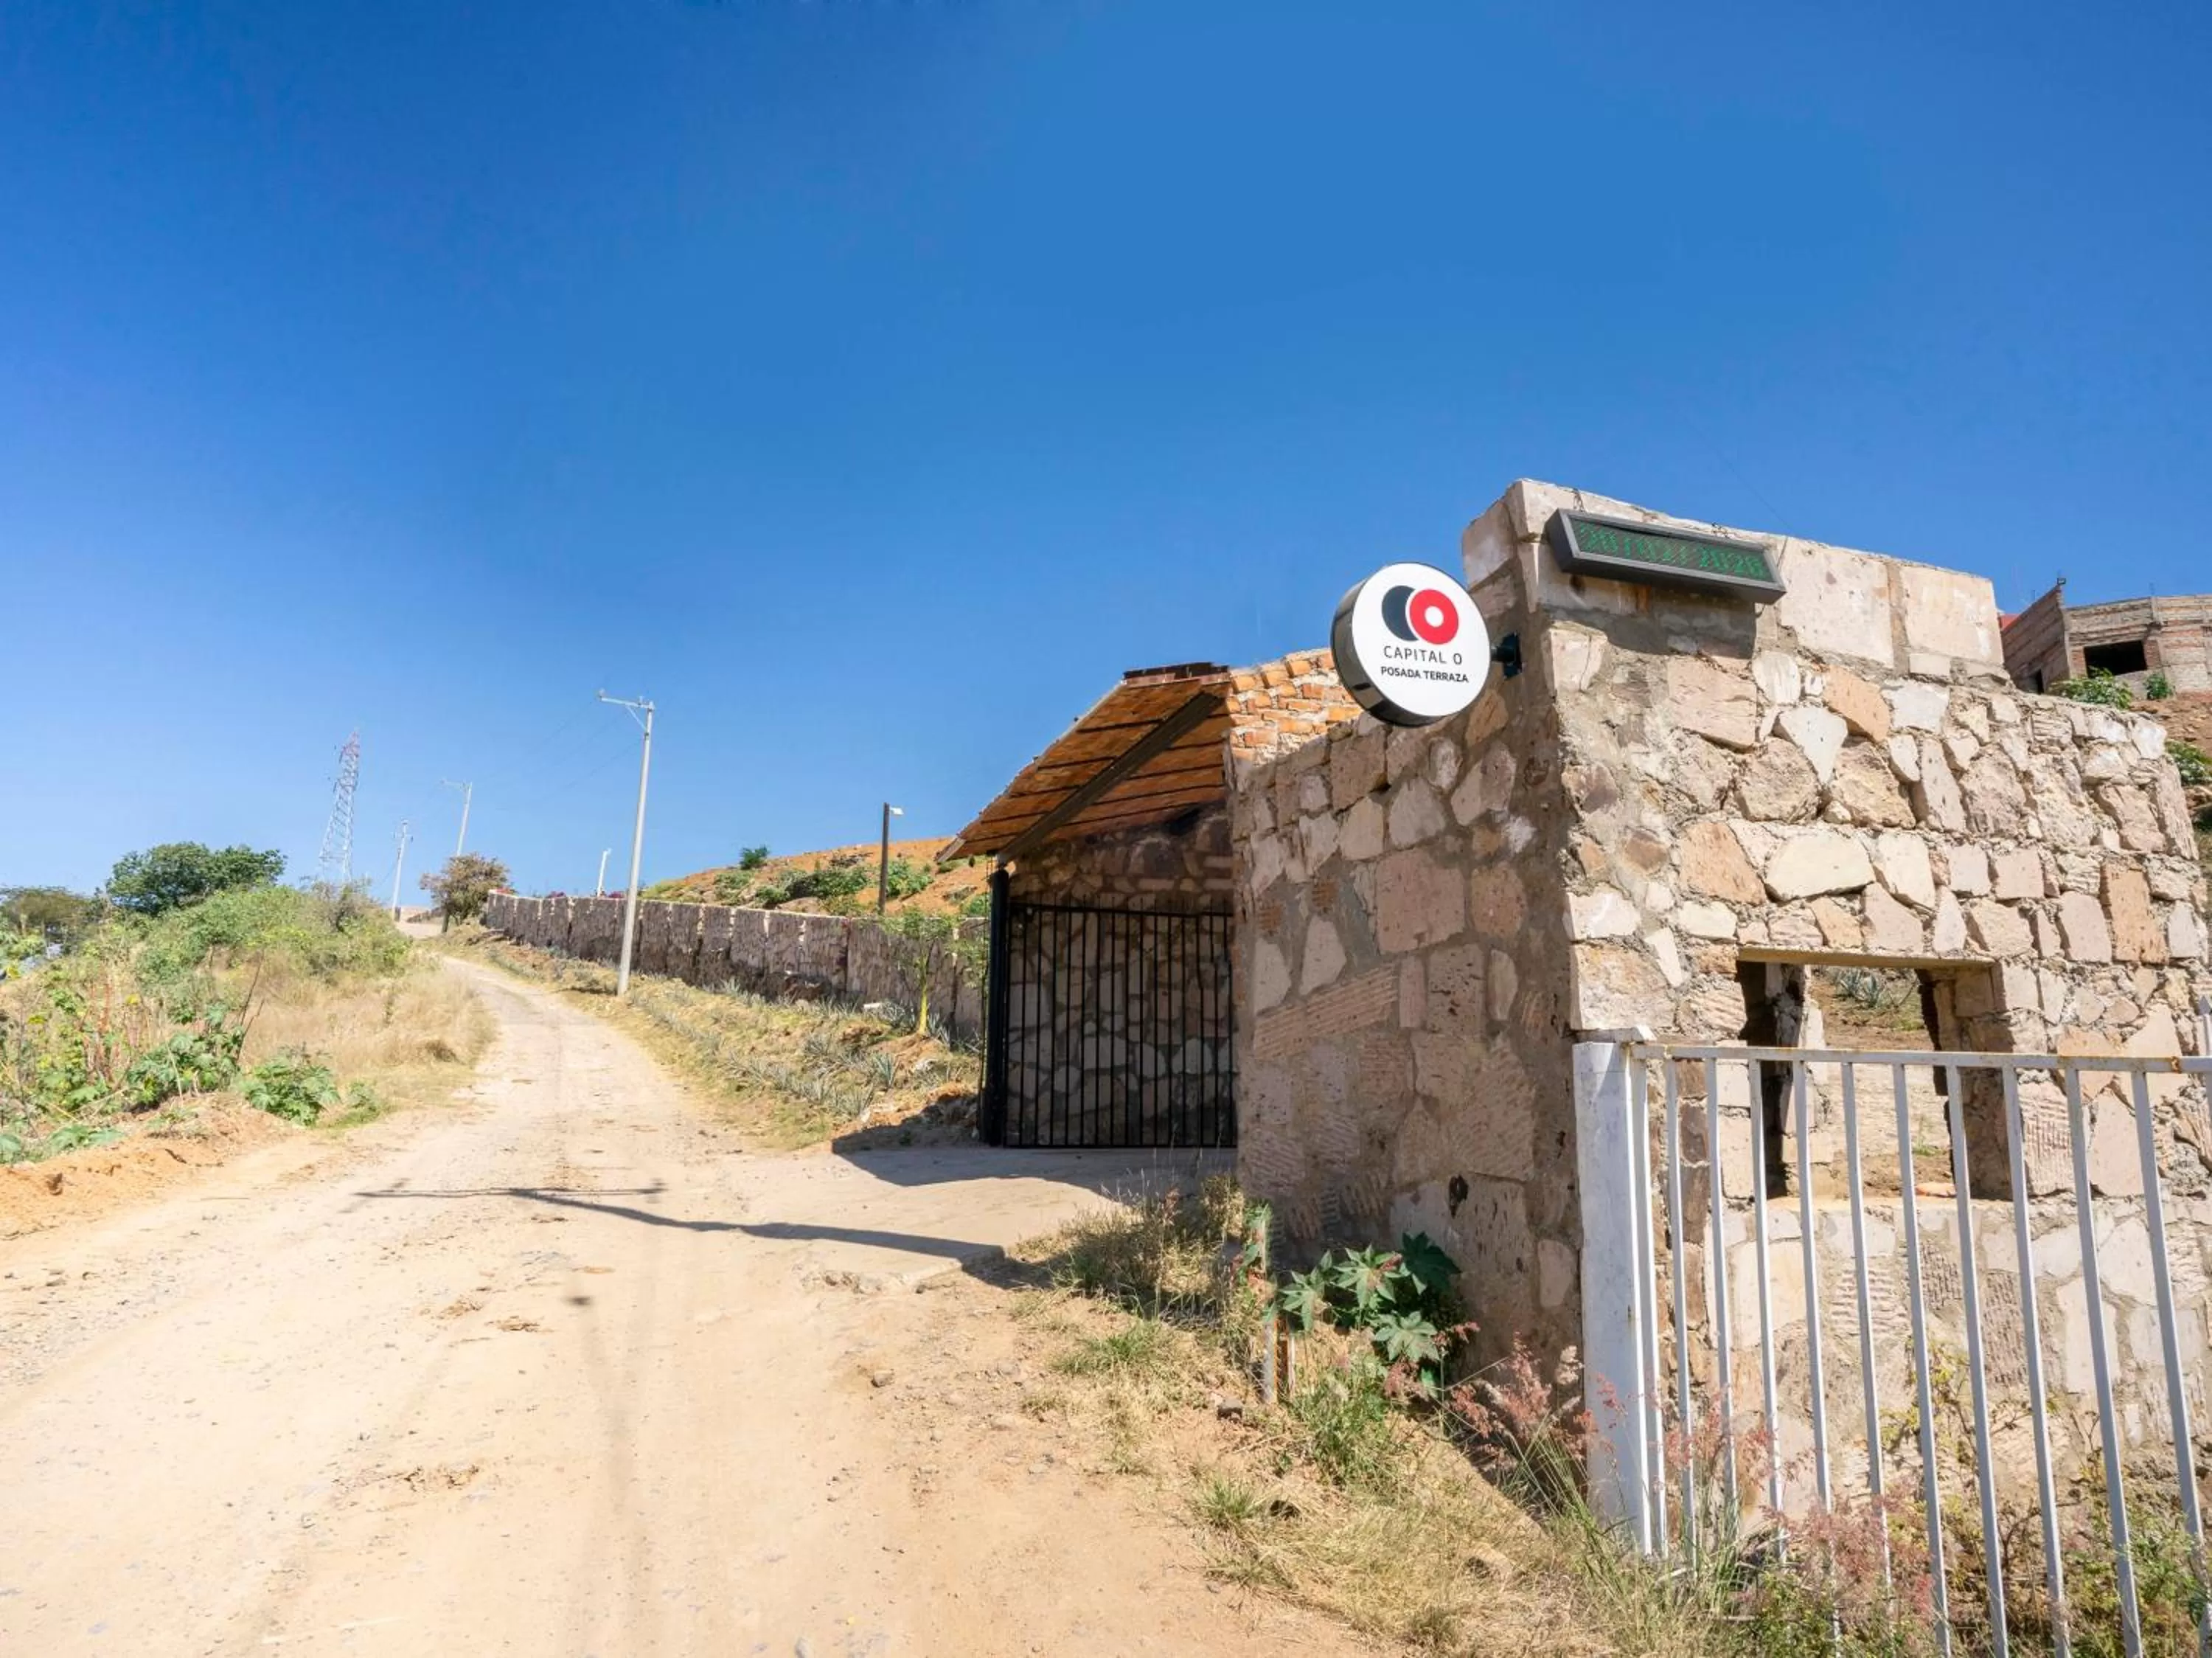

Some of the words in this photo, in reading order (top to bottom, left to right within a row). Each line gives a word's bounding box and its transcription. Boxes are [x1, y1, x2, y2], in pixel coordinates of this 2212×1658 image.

[1383, 645, 1447, 664] CAPITAL
[1453, 653, 1463, 665] O
[1381, 666, 1421, 679] POSADA
[1423, 670, 1470, 683] TERRAZA
